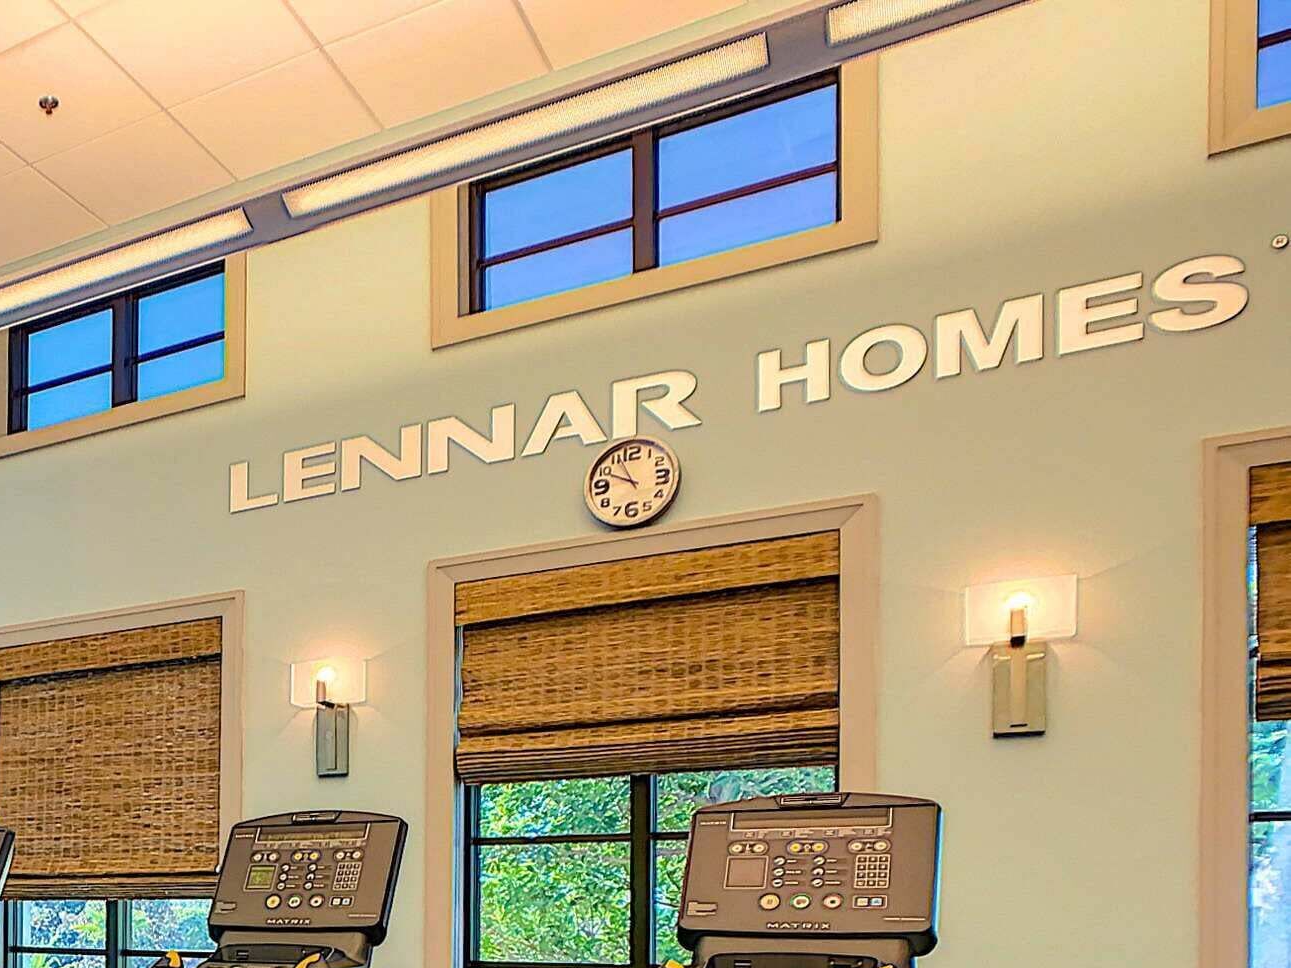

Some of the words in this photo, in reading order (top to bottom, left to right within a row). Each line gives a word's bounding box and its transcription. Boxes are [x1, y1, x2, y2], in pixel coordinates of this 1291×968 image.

[228, 368, 702, 514] LENNAR
[755, 254, 1248, 414] HOMES
[623, 445, 641, 461] 12
[647, 448, 652, 459] 1
[655, 456, 665, 467] 2
[599, 466, 612, 477] 10
[655, 468, 670, 485] 3
[594, 479, 610, 496] 9
[654, 489, 664, 499] 4
[600, 498, 610, 508] 8
[642, 501, 652, 512] 5
[613, 506, 621, 516] 7
[624, 501, 638, 518] 6
[766, 921, 831, 930] MATRIX
